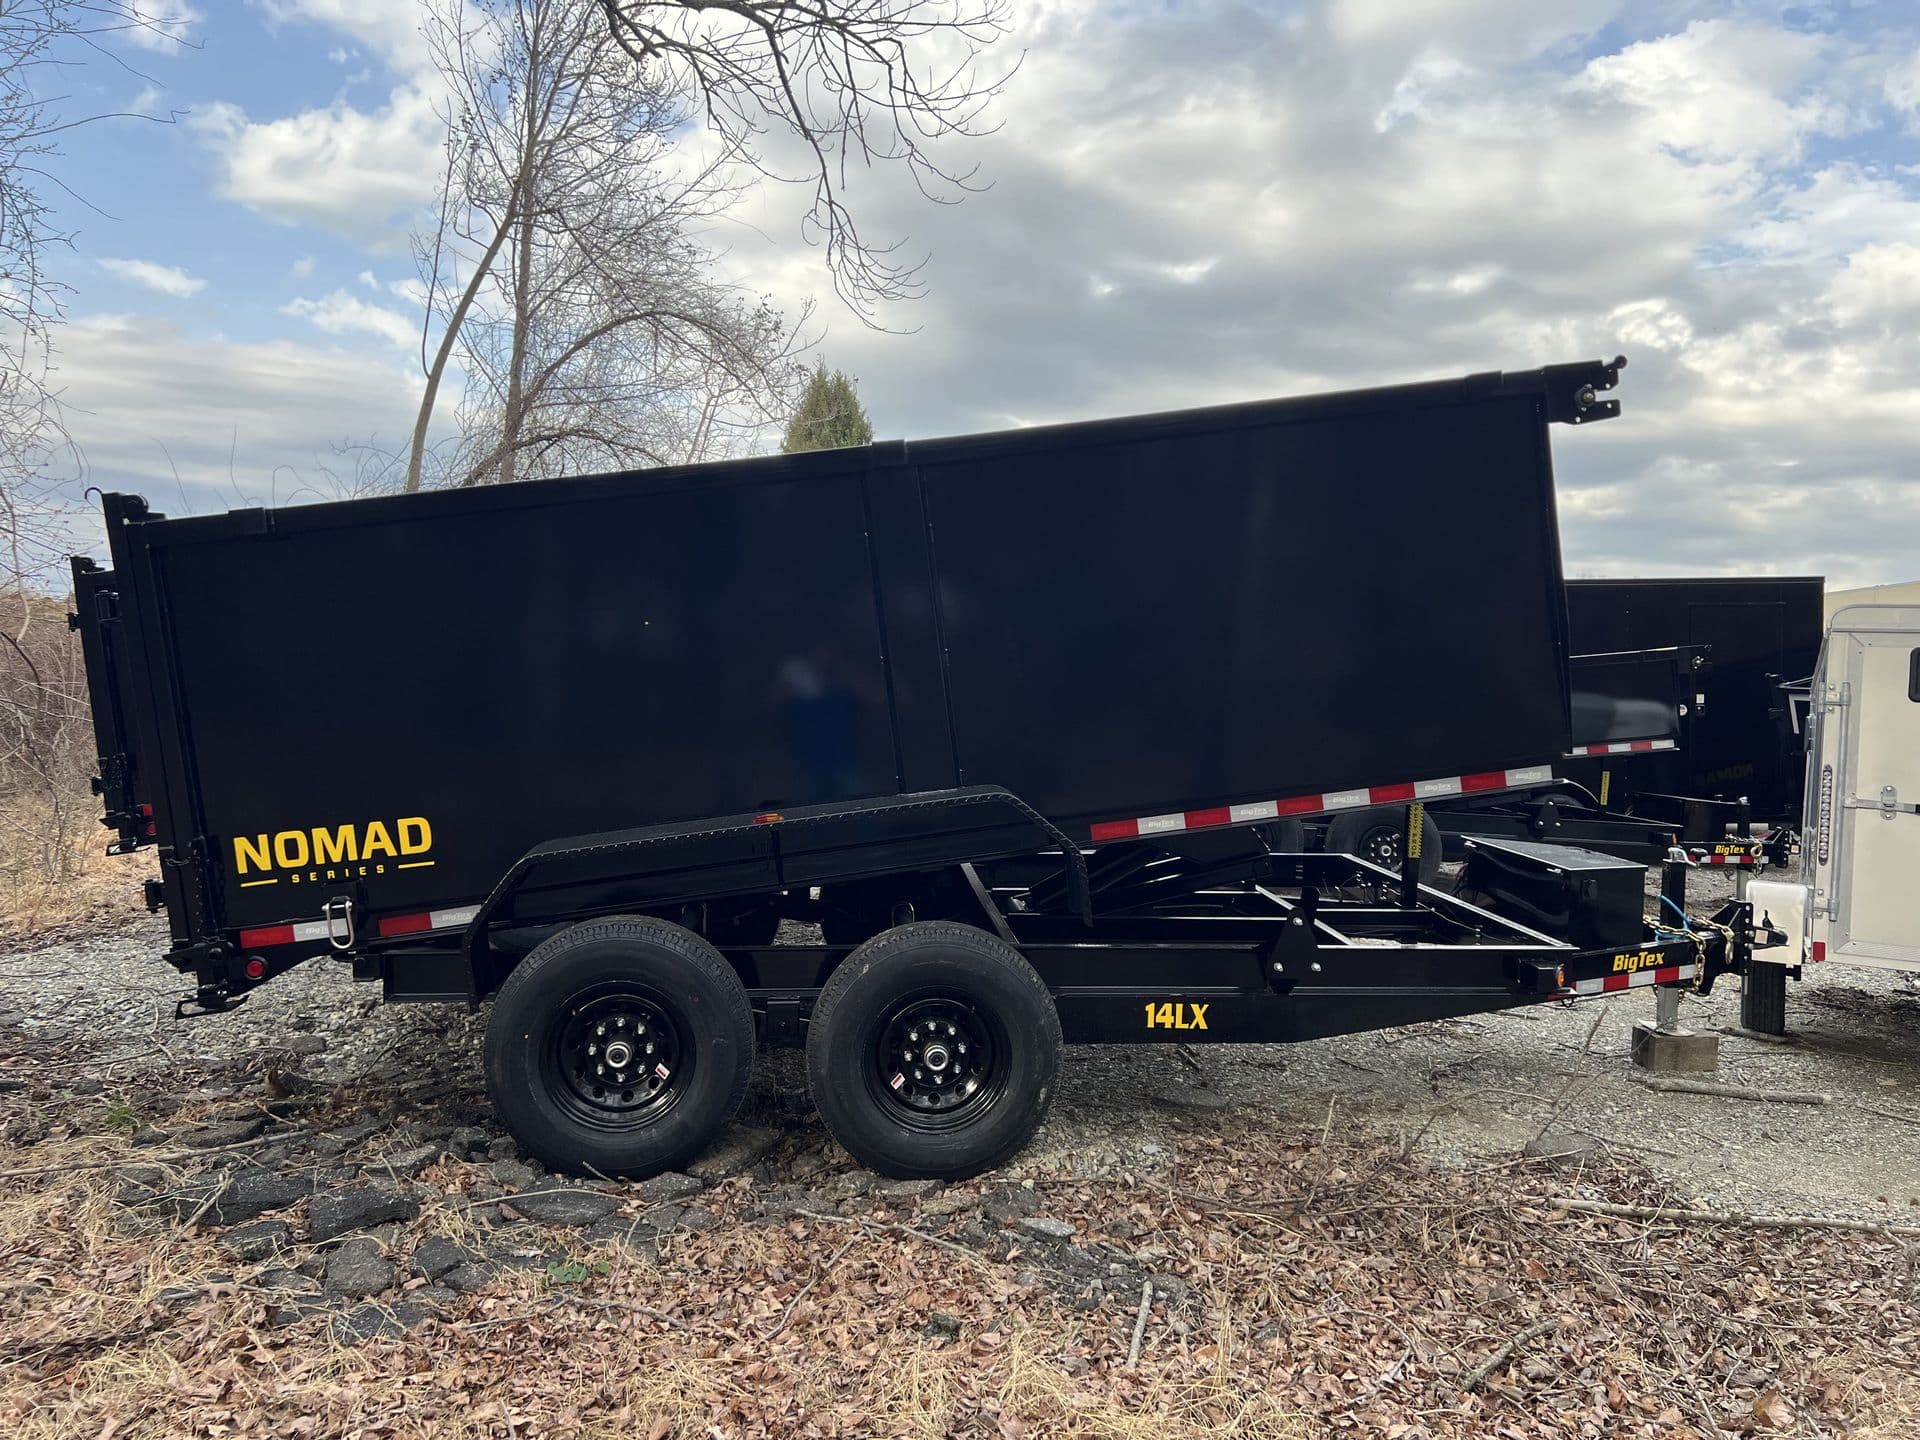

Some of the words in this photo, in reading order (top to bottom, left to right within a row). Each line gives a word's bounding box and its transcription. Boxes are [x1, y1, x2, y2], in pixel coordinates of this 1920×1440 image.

[233, 816, 433, 874] NOMAD
[1715, 844, 1745, 855] BigTex
[291, 864, 385, 883] SERIES
[1612, 952, 1665, 973] BigTex
[1145, 1002, 1209, 1029] 14LX
